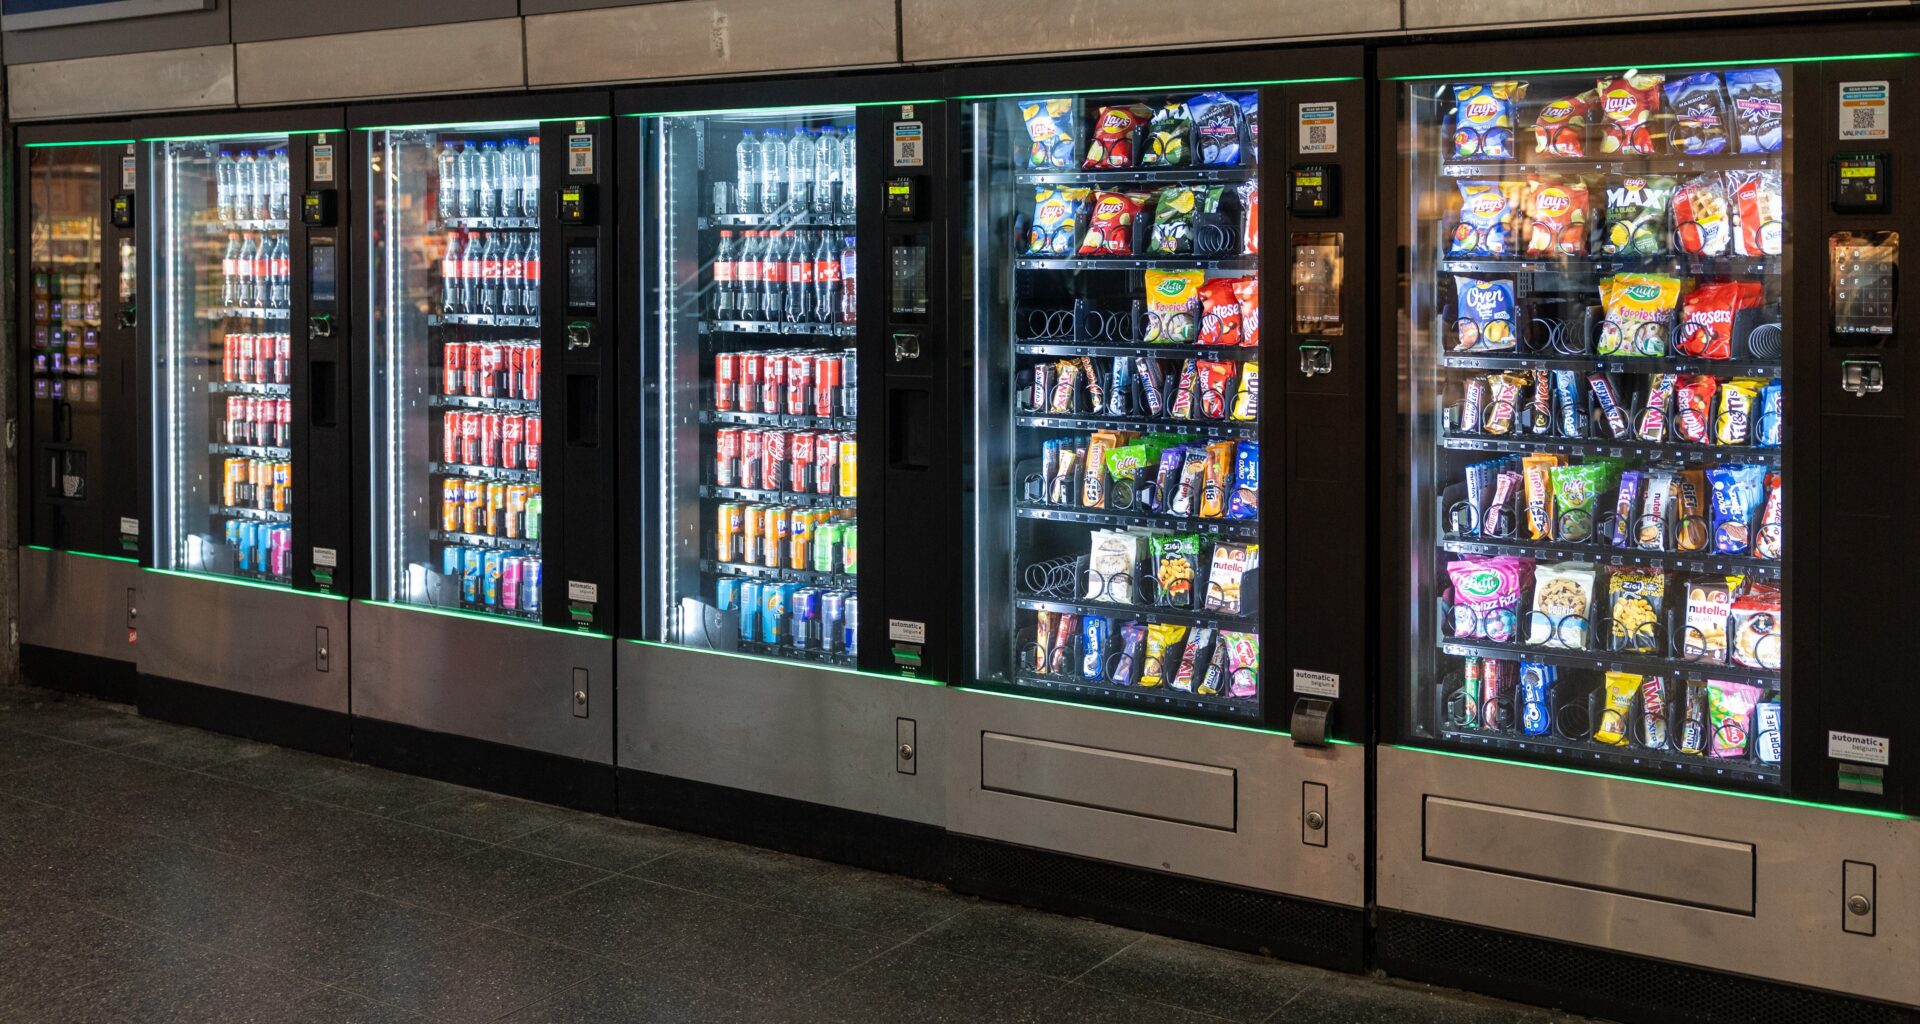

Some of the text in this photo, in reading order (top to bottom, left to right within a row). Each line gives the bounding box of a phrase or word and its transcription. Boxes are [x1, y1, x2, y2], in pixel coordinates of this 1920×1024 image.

[1467, 99, 1498, 117] Lay's
[1604, 95, 1636, 113] Lay's
[1677, 93, 1709, 108] MAMMOET
[1543, 105, 1574, 118] Lay's
[1104, 115, 1130, 128] Lay's
[1624, 179, 1646, 187] Lay's
[1537, 194, 1569, 209] Lay's
[1606, 187, 1661, 209] MAX
[1097, 202, 1123, 214] Lay's
[1466, 287, 1504, 308] Oven
[1202, 304, 1240, 336] Maltese
[1058, 370, 1073, 407] TWIX
[1174, 372, 1191, 412] TWIX
[1494, 384, 1517, 422] TWIX
[1592, 380, 1618, 418] SNICKERS
[1643, 389, 1665, 432] TWIX
[1681, 481, 1699, 509] BiFi
[1651, 492, 1662, 523] nutella
[1213, 561, 1244, 573] nutella
[1462, 575, 1498, 592] Lutti
[1688, 604, 1728, 617] nutella
[891, 621, 919, 630] automatic
[1177, 642, 1199, 684] TWIX
[1205, 667, 1217, 688] KIND
[1295, 672, 1331, 682] automatic
[1642, 675, 1662, 722] TWIX
[1686, 727, 1695, 749] KIND
[1831, 734, 1878, 746] automatic
[1851, 744, 1878, 753] belgium
